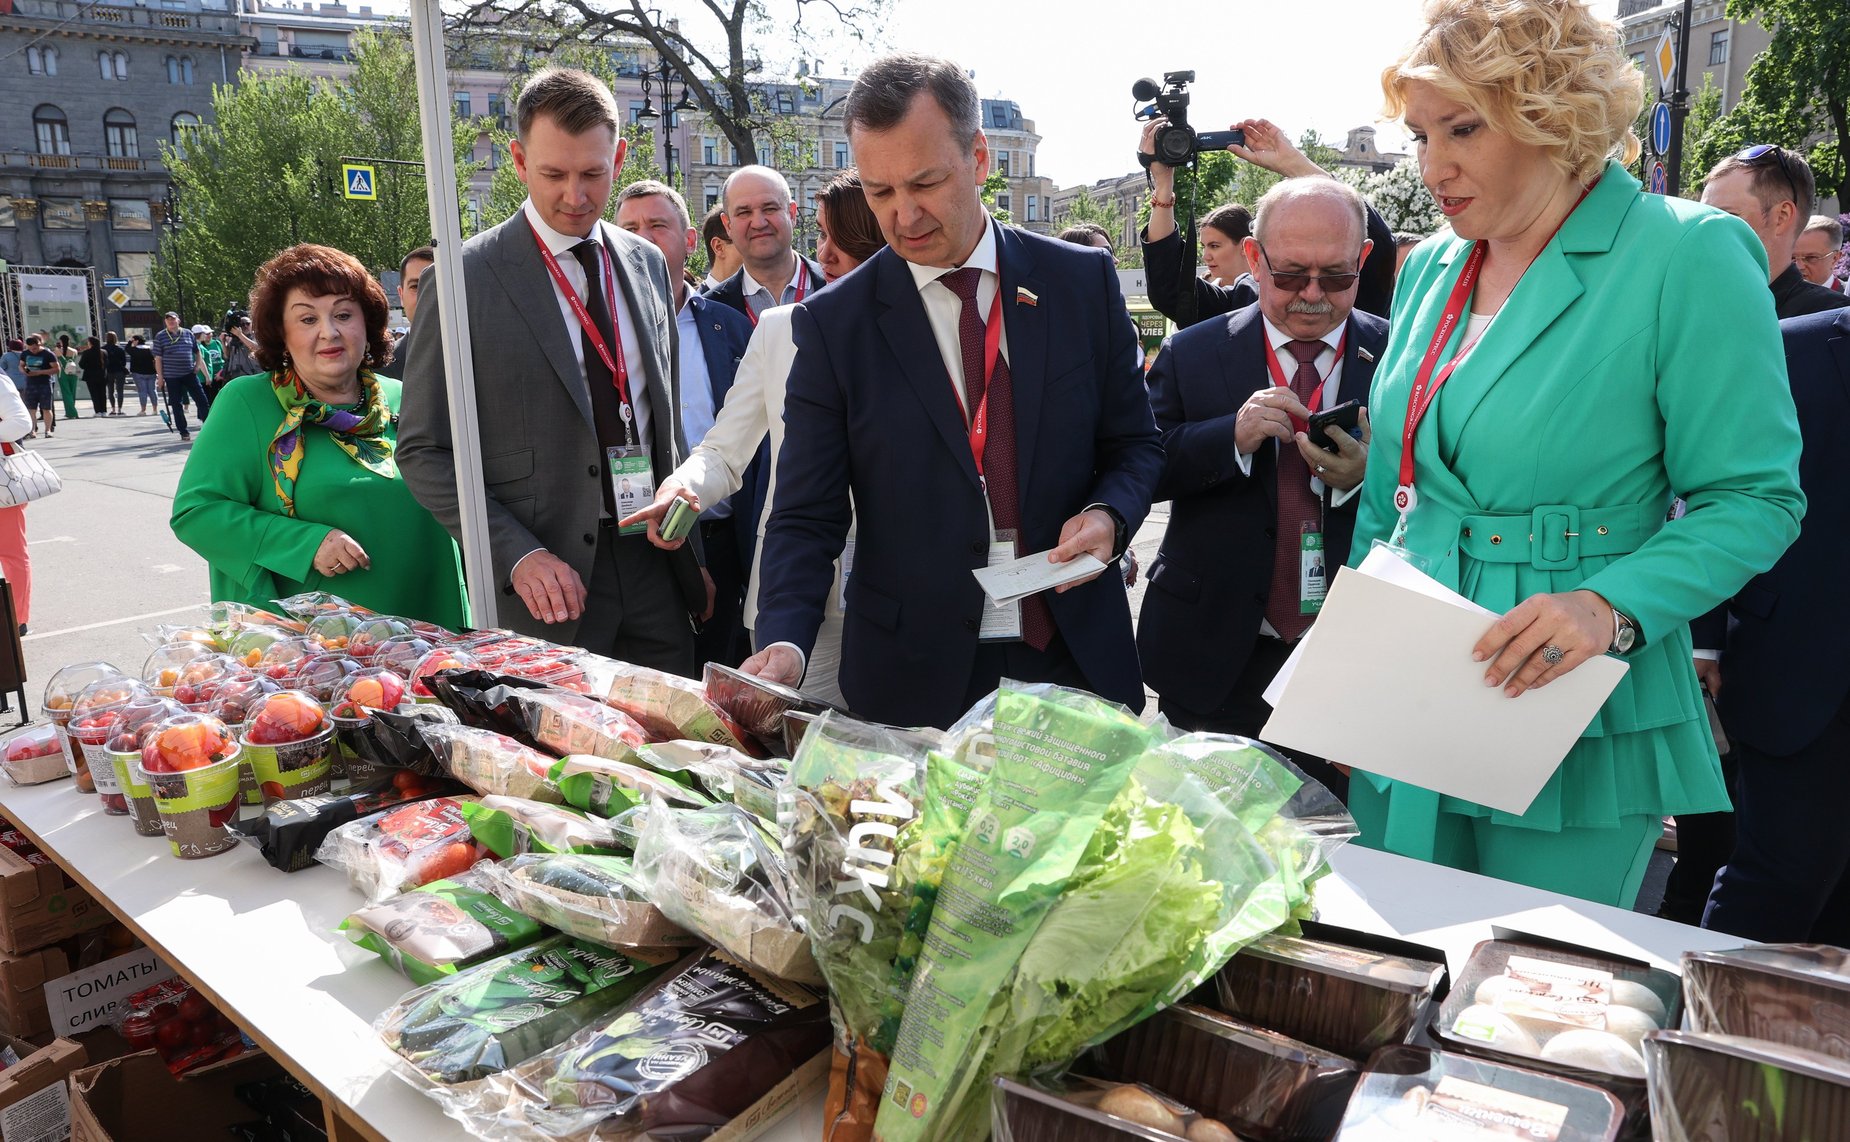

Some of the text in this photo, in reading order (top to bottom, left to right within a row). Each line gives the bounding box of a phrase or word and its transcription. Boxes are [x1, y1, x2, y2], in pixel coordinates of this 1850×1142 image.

[1141, 328, 1164, 336] ХЛЕБ
[1043, 732, 1107, 762] защищенного
[1052, 751, 1091, 771] батавия
[980, 820, 994, 834] 0,2
[1012, 836, 1029, 849] 2,0
[566, 947, 635, 980] Огурцы
[62, 957, 159, 1003] ТОМАТЫ
[691, 965, 790, 1014] Баклажаны
